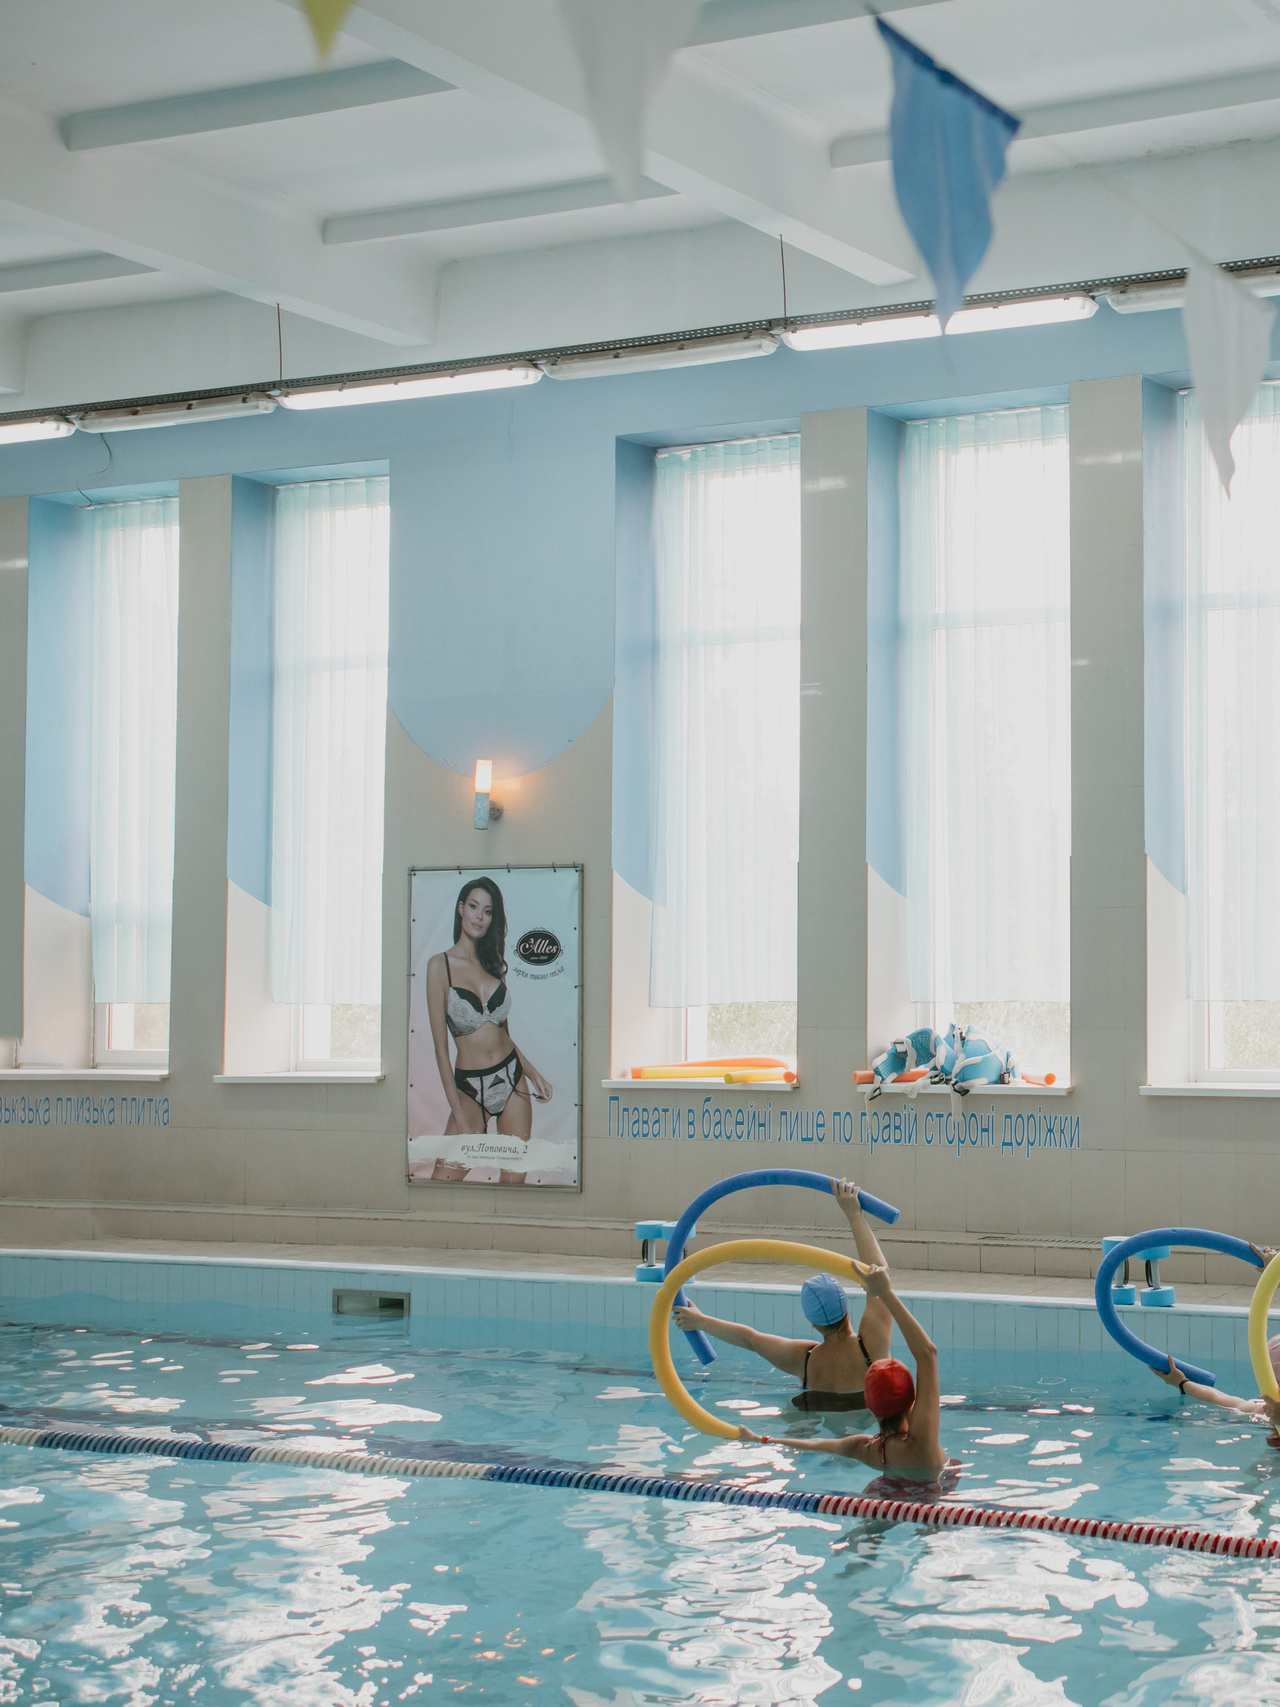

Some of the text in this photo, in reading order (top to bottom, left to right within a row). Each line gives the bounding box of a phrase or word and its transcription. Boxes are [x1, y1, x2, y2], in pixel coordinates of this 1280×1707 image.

[520, 938, 558, 954] Alles
[121, 1097, 169, 1126] плитка
[608, 1096, 1081, 1158] Плавати в басейні лише по правій стороні доріжки
[523, 1145, 528, 1154] 2
